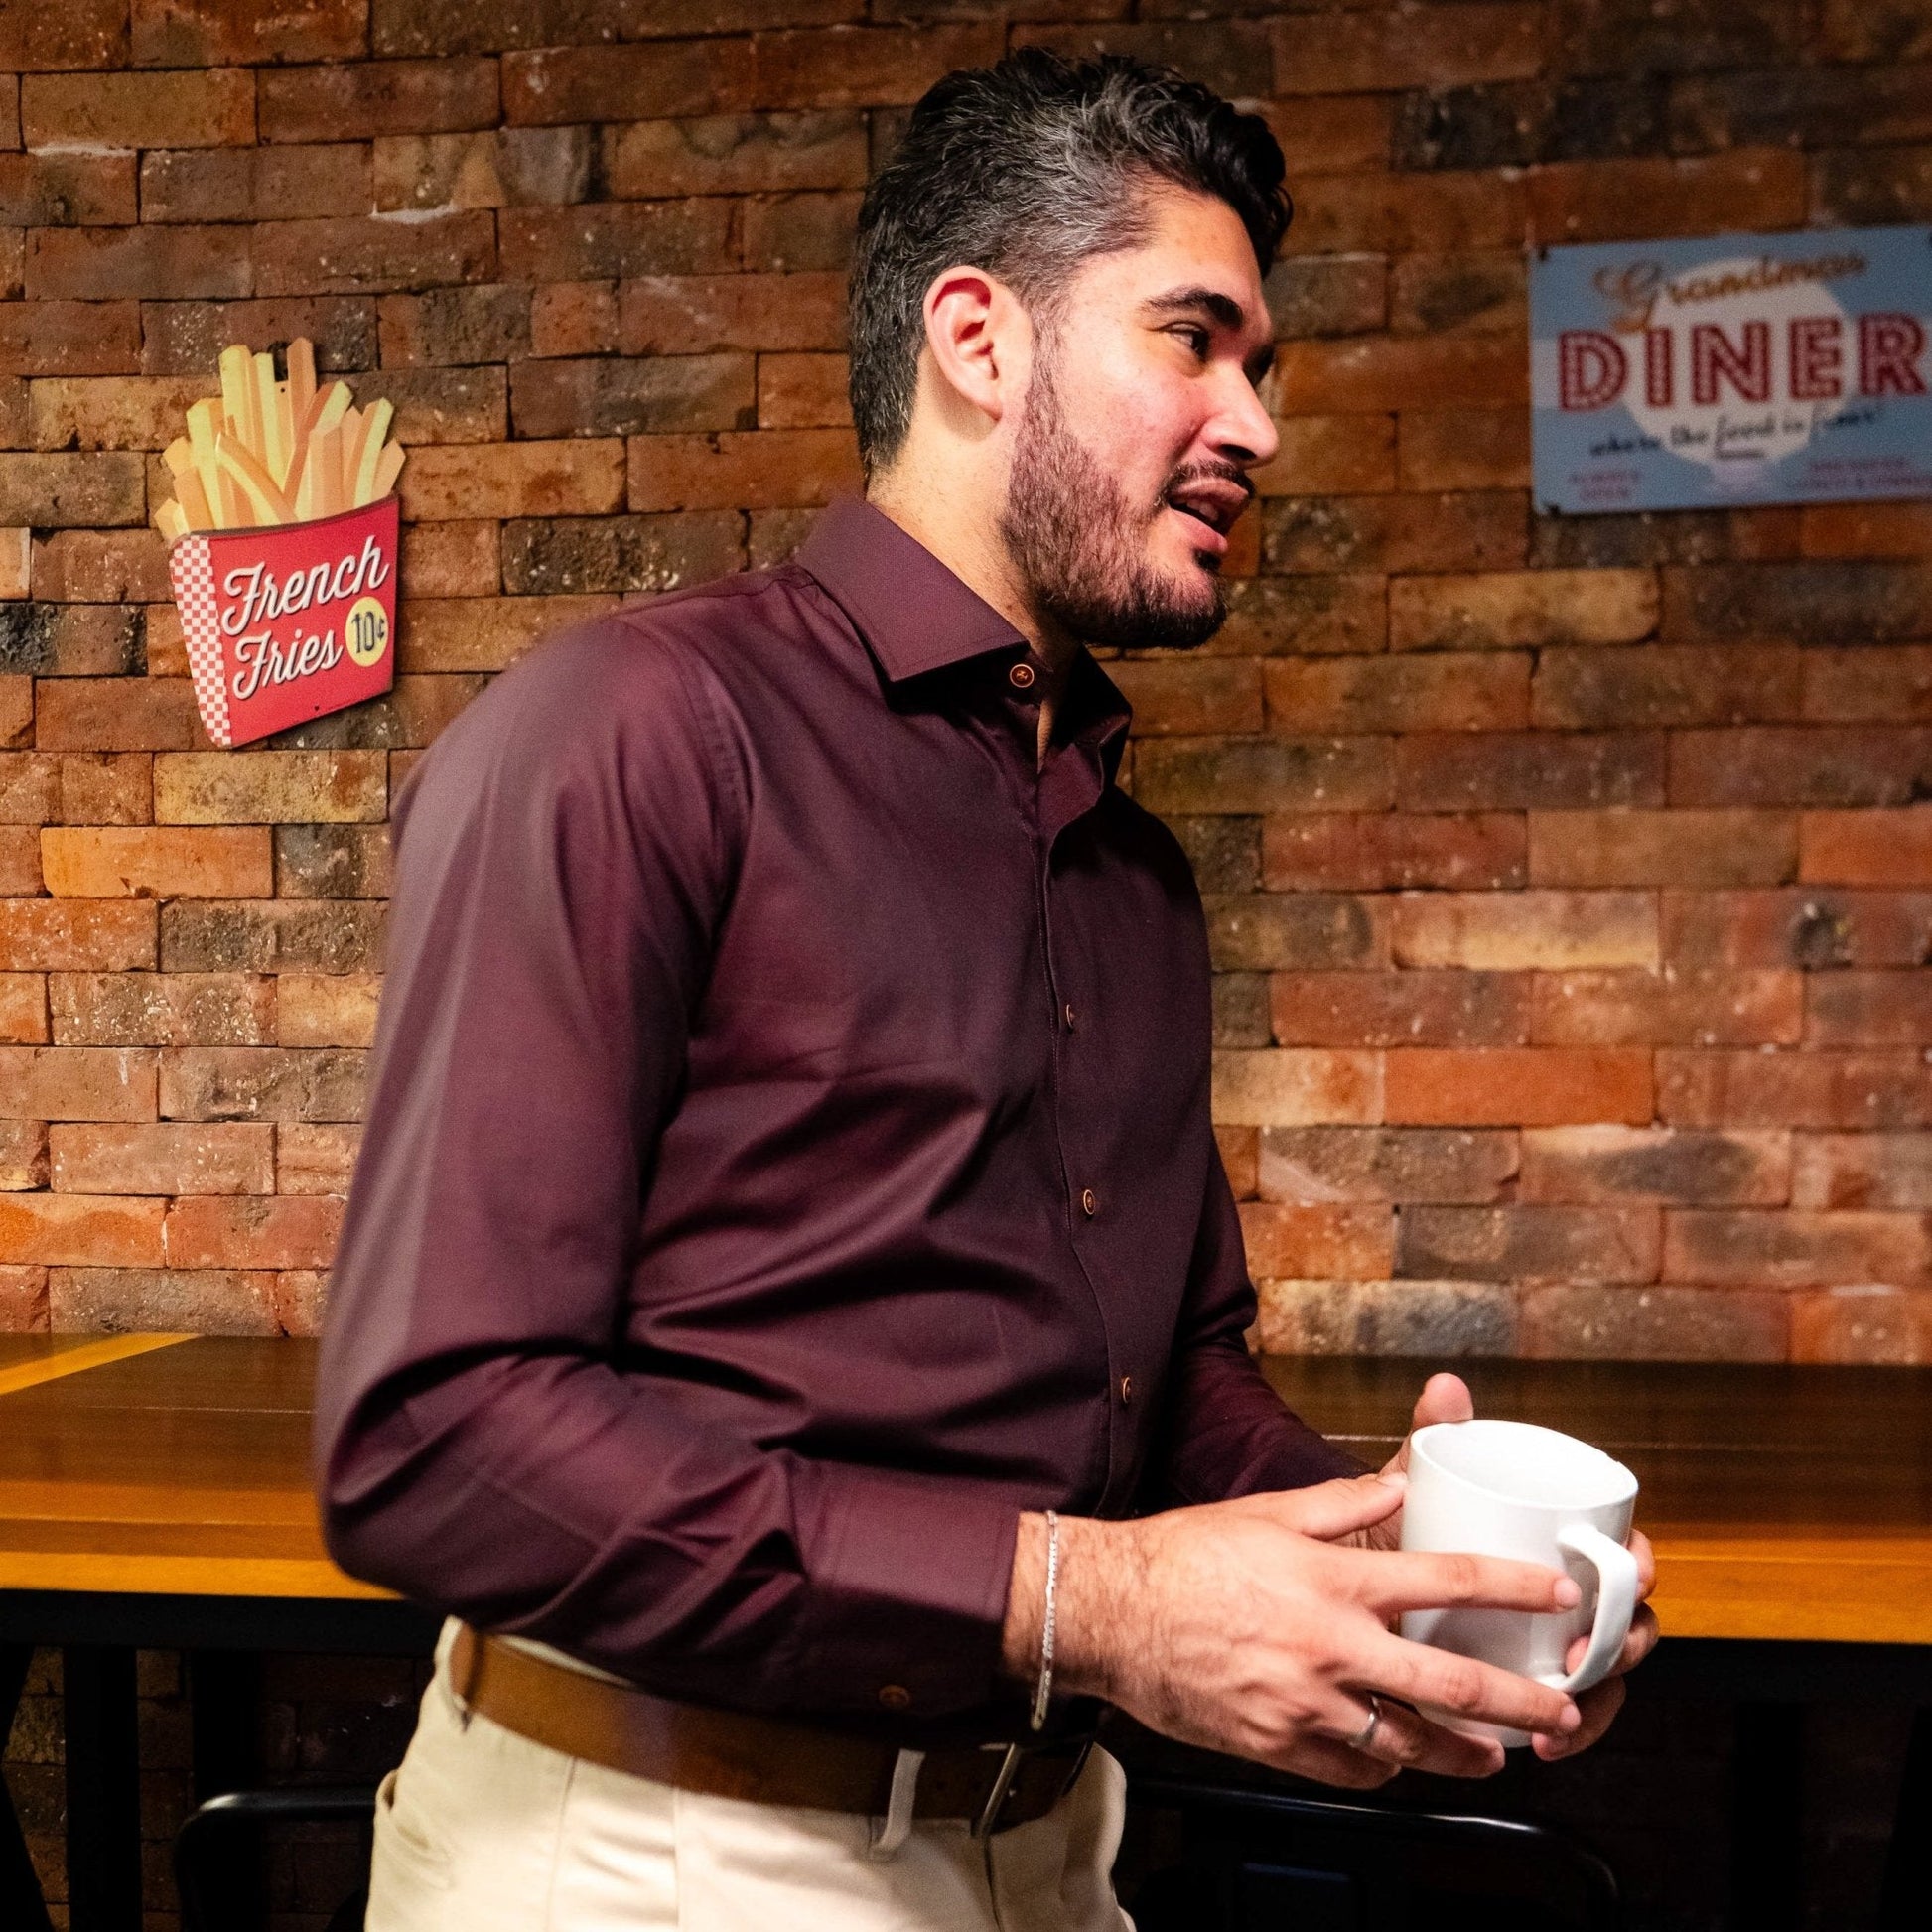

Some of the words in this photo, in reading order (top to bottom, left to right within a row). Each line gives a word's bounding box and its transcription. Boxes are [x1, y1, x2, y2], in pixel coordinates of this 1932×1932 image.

[1558, 310, 1929, 413] DINER
[1670, 424, 1710, 446] the
[1714, 412, 1776, 460] food
[220, 534, 390, 637] French
[232, 628, 344, 701] Fries
